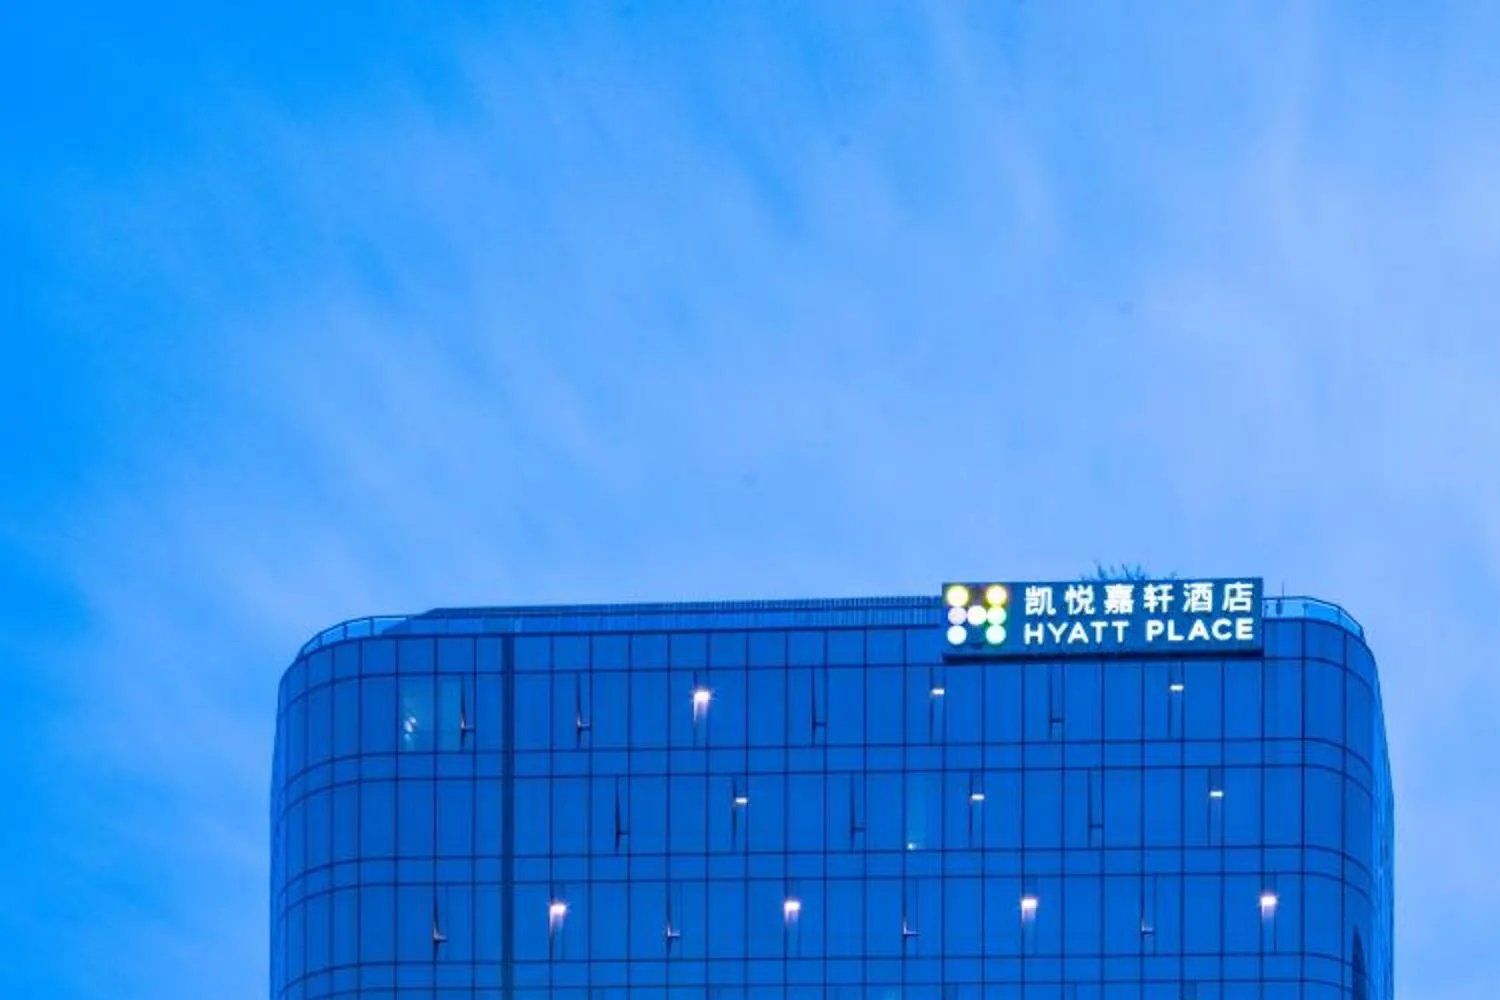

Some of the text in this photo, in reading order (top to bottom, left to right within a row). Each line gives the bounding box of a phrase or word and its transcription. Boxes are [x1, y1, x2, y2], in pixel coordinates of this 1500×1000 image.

[1024, 583, 1254, 616] 凯悦嘉轩酒店
[1024, 617, 1254, 645] HYATT PLACE
